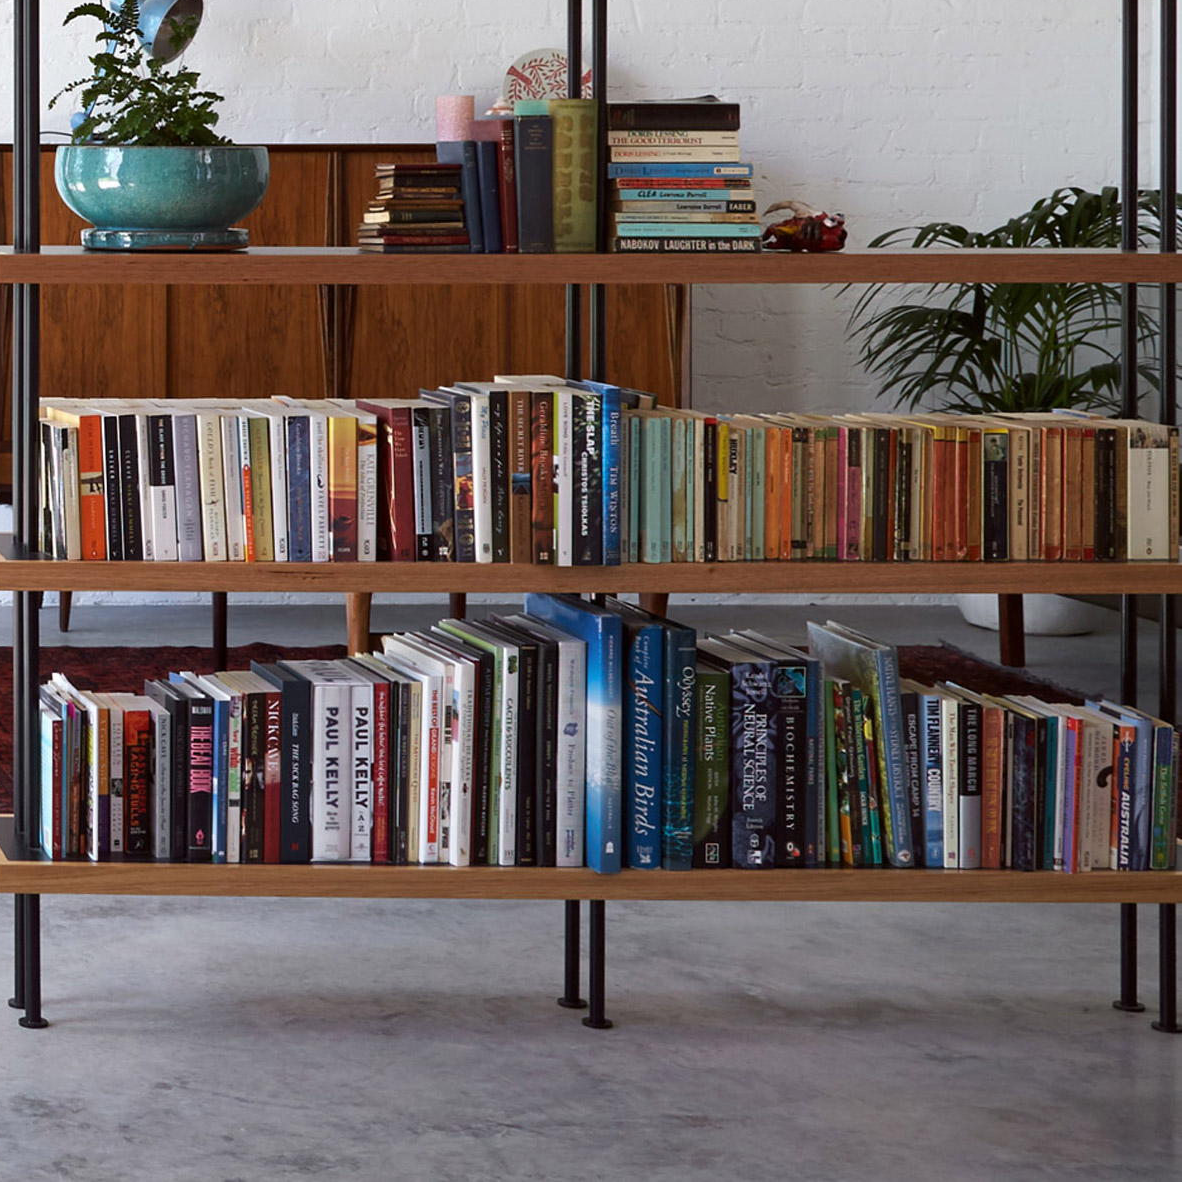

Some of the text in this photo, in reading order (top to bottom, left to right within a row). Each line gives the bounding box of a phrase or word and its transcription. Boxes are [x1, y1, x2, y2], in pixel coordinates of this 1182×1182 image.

[630, 137, 656, 145] GOOD
[658, 137, 703, 145] TERRORIST
[620, 239, 755, 250] NABOKOV LAUGHTER in the DARK
[516, 400, 525, 473] THE SECRET RIVER
[538, 401, 549, 481] Geraldine Brooks
[586, 401, 596, 456] THE SLAP
[729, 438, 738, 476] HUXLEY
[124, 449, 132, 480] CLEAVE
[181, 417, 194, 518] RICHARD FLANAGAN
[209, 478, 217, 498] FISH
[366, 453, 375, 526] KATE GRENVILLE
[609, 411, 620, 534] Breath TIM WINTON
[318, 490, 326, 514] FAVEL
[581, 451, 589, 537] CHRISTOS TSIOLKAS
[634, 634, 642, 653] Book
[641, 634, 651, 669] Complete
[505, 697, 514, 725] CACTI
[675, 665, 696, 717] Odyssey
[267, 699, 280, 773] NICK CAVE
[430, 728, 438, 752] GRAND
[431, 718, 438, 727] OF
[465, 689, 474, 781] TRADITIONAL HEALERS
[606, 708, 618, 732] Out
[606, 735, 618, 748] of
[704, 684, 717, 762] Native Plants
[716, 703, 727, 762] Australian
[853, 698, 866, 781] The Wilderness Garden
[883, 656, 904, 799] NATIVE PLANTS SYDNEY DISTRICT
[189, 724, 213, 794] THE BEAT BOOK
[229, 747, 241, 769] white
[291, 743, 300, 761] THE
[291, 762, 300, 781] SICK
[325, 706, 339, 809] PAUL KELLY
[355, 706, 369, 809] PAUL KELLY
[504, 734, 513, 790] SUCCULENTS
[567, 744, 576, 775] Produce
[606, 748, 618, 765] the
[634, 667, 656, 836] Australian Birds
[742, 703, 755, 811] NEURAL SCIENCE
[754, 713, 767, 802] PRINCIPLES OF
[785, 716, 795, 831] BIOCHEMISTRY
[807, 766, 815, 786] PARKS
[907, 713, 921, 818] ESCAPE FROM CAMP 14
[927, 700, 942, 812] TIM FLANNERY COUNTRY
[947, 712, 957, 804] The Man Who Tasted Shapes
[966, 708, 979, 792] THE LONG MARCH
[1093, 730, 1101, 771] DIAMOND
[130, 746, 139, 827] RAGING BULLS
[138, 746, 147, 814] EASY RIDERS
[291, 782, 300, 799] BAG
[567, 790, 576, 817] Platter
[606, 767, 618, 791] Blue
[1158, 767, 1168, 825] The Selfish Gene
[291, 800, 300, 824] SONG
[1120, 756, 1131, 867] CYCLING AUSTRALIA
